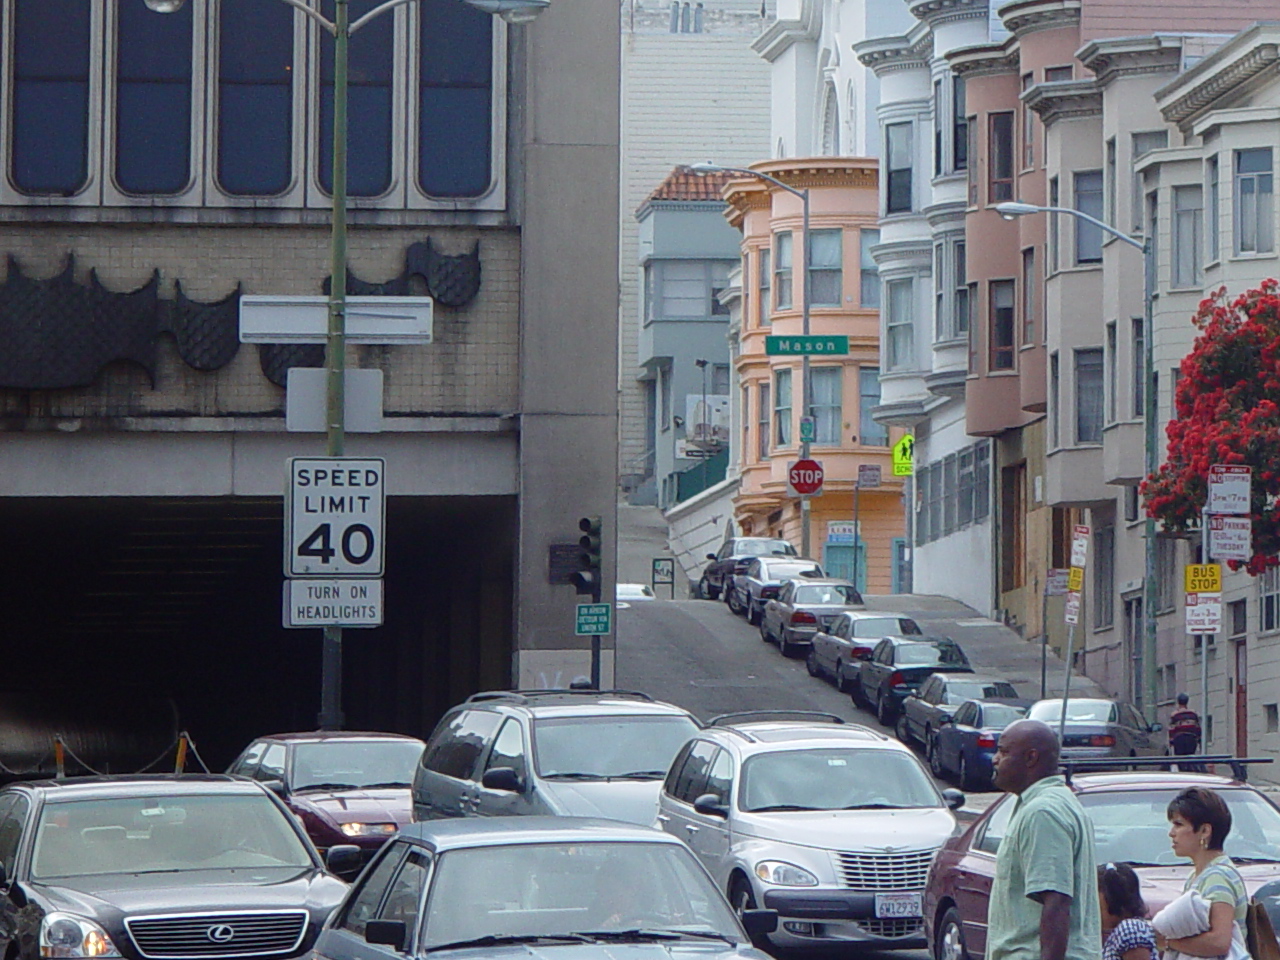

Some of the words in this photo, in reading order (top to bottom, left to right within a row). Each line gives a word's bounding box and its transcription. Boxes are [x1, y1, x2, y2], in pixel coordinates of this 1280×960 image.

[778, 340, 836, 352] Mason
[297, 469, 379, 487] SPEED
[790, 470, 824, 484] STOP
[305, 496, 371, 513] LIMIT
[1224, 521, 1250, 530] PARKING
[297, 523, 375, 565] 40
[1216, 542, 1245, 551] TUESDAY
[1193, 567, 1215, 578] BUS
[1190, 579, 1218, 590] STOP
[307, 587, 340, 599] TURN
[351, 587, 368, 599] ON
[297, 606, 376, 619] HEADLIGHTS
